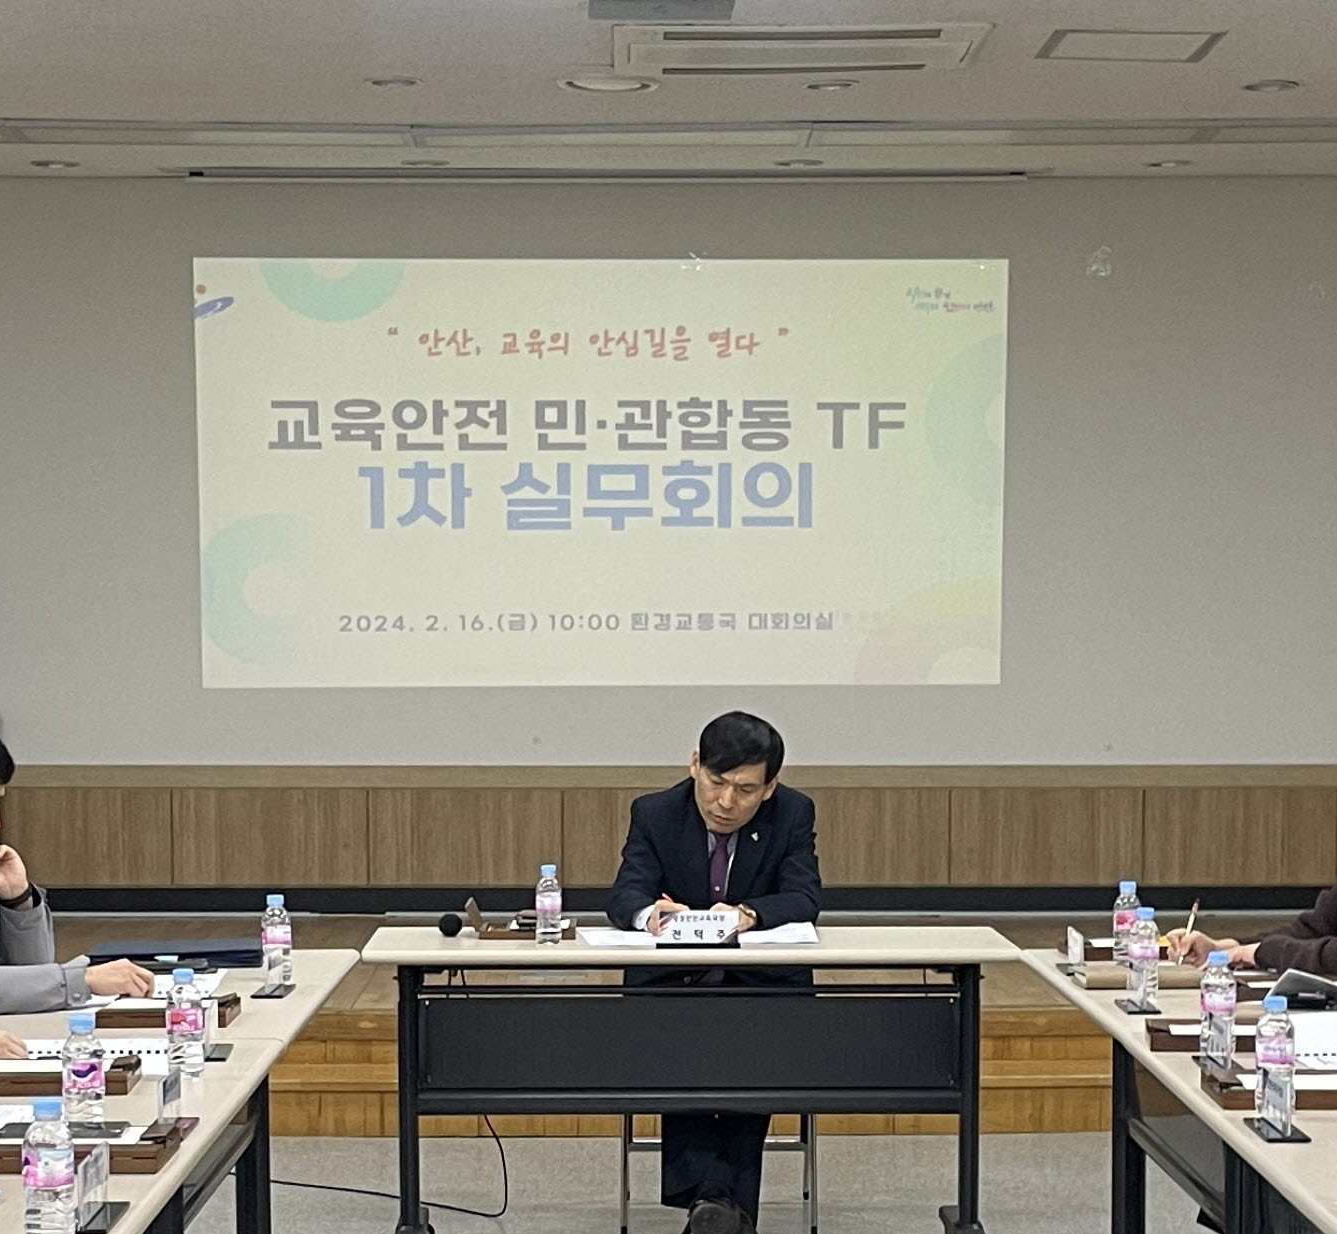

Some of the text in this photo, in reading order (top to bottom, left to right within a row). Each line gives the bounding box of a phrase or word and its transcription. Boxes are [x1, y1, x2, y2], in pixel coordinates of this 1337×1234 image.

[417, 327, 482, 358] 안산,
[499, 328, 570, 361] 교육의
[588, 324, 692, 362] 안심길을
[707, 326, 762, 360] 열다
[267, 396, 907, 452] 교육안전 민·관합동 TF
[357, 459, 813, 532] 1차 실무회의
[338, 614, 415, 633] 2024.
[425, 614, 448, 633] 2.
[548, 613, 621, 632] 10:00
[747, 611, 834, 632] 대회의실
